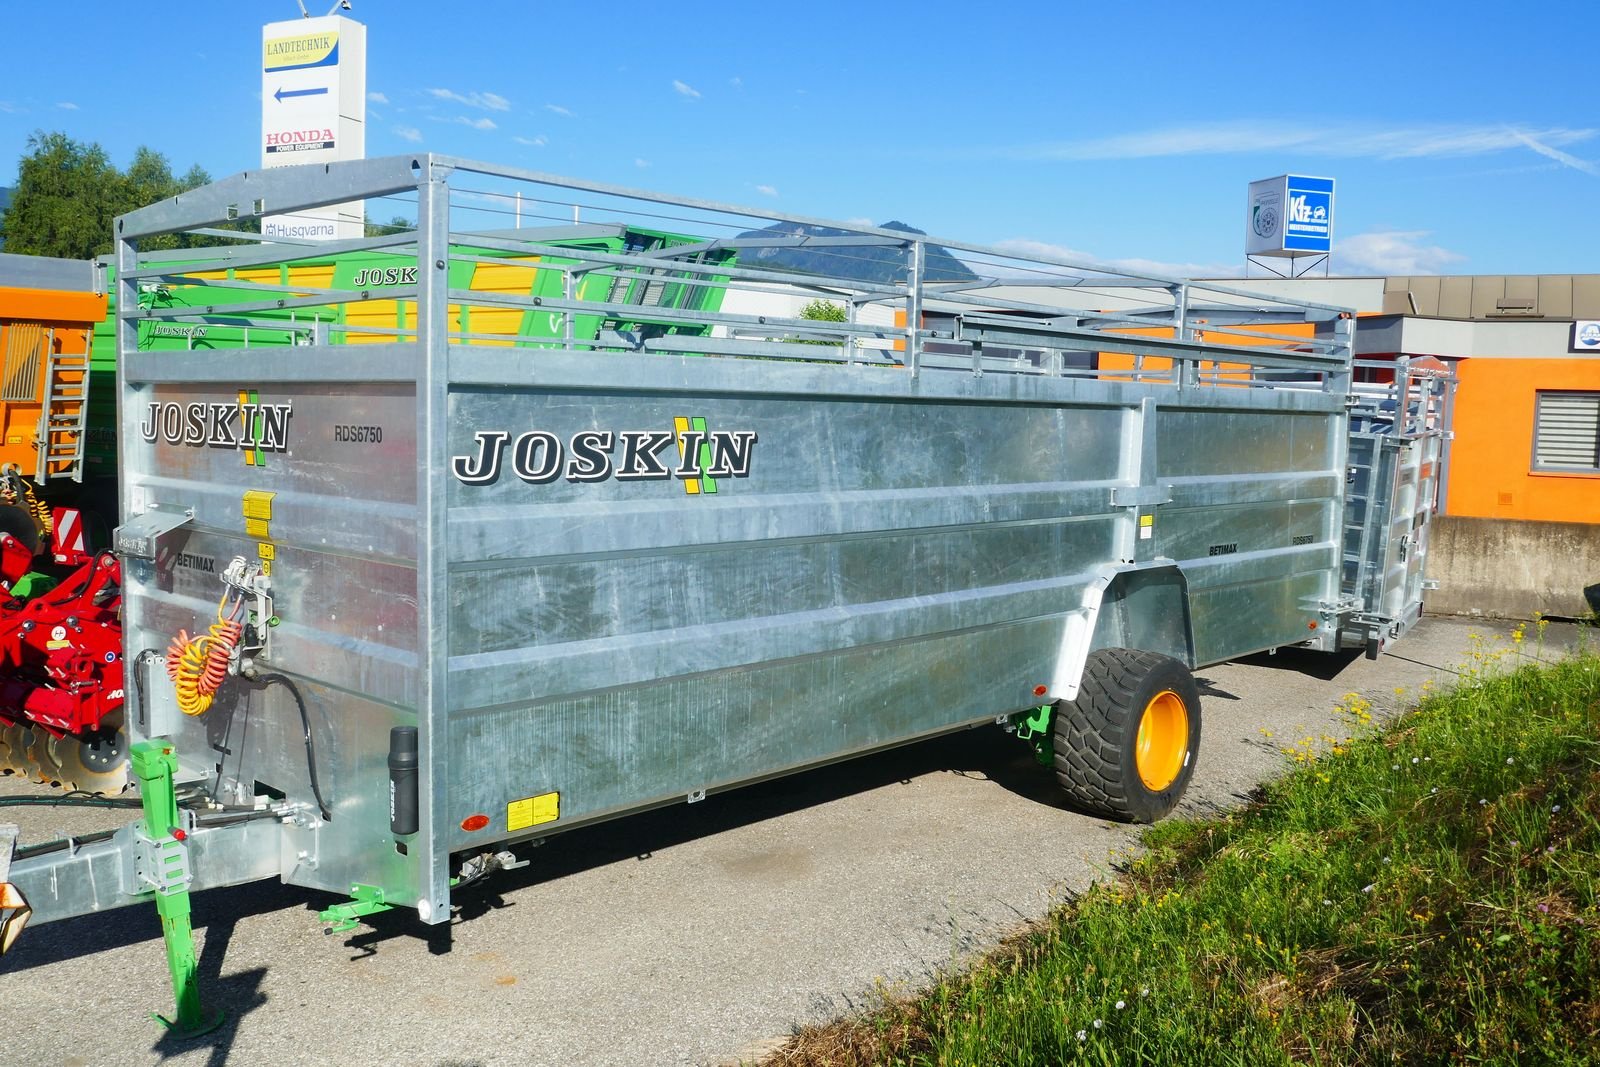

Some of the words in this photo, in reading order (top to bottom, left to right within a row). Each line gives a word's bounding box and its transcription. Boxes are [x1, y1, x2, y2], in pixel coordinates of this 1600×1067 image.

[267, 37, 330, 55] LANDTECHNIK
[266, 128, 335, 145] HONDA
[276, 144, 295, 152] POWER
[295, 142, 324, 151] EQUIPMENT
[1289, 194, 1313, 223] Kfz
[277, 224, 334, 238] Husqvarna
[354, 266, 418, 287] JOSK
[141, 400, 292, 452] JOSKIN
[334, 424, 383, 444] RDS6750
[451, 429, 759, 486] JOSKIN
[1209, 543, 1238, 557] BETIMAX
[177, 553, 215, 573] BETIMAX
